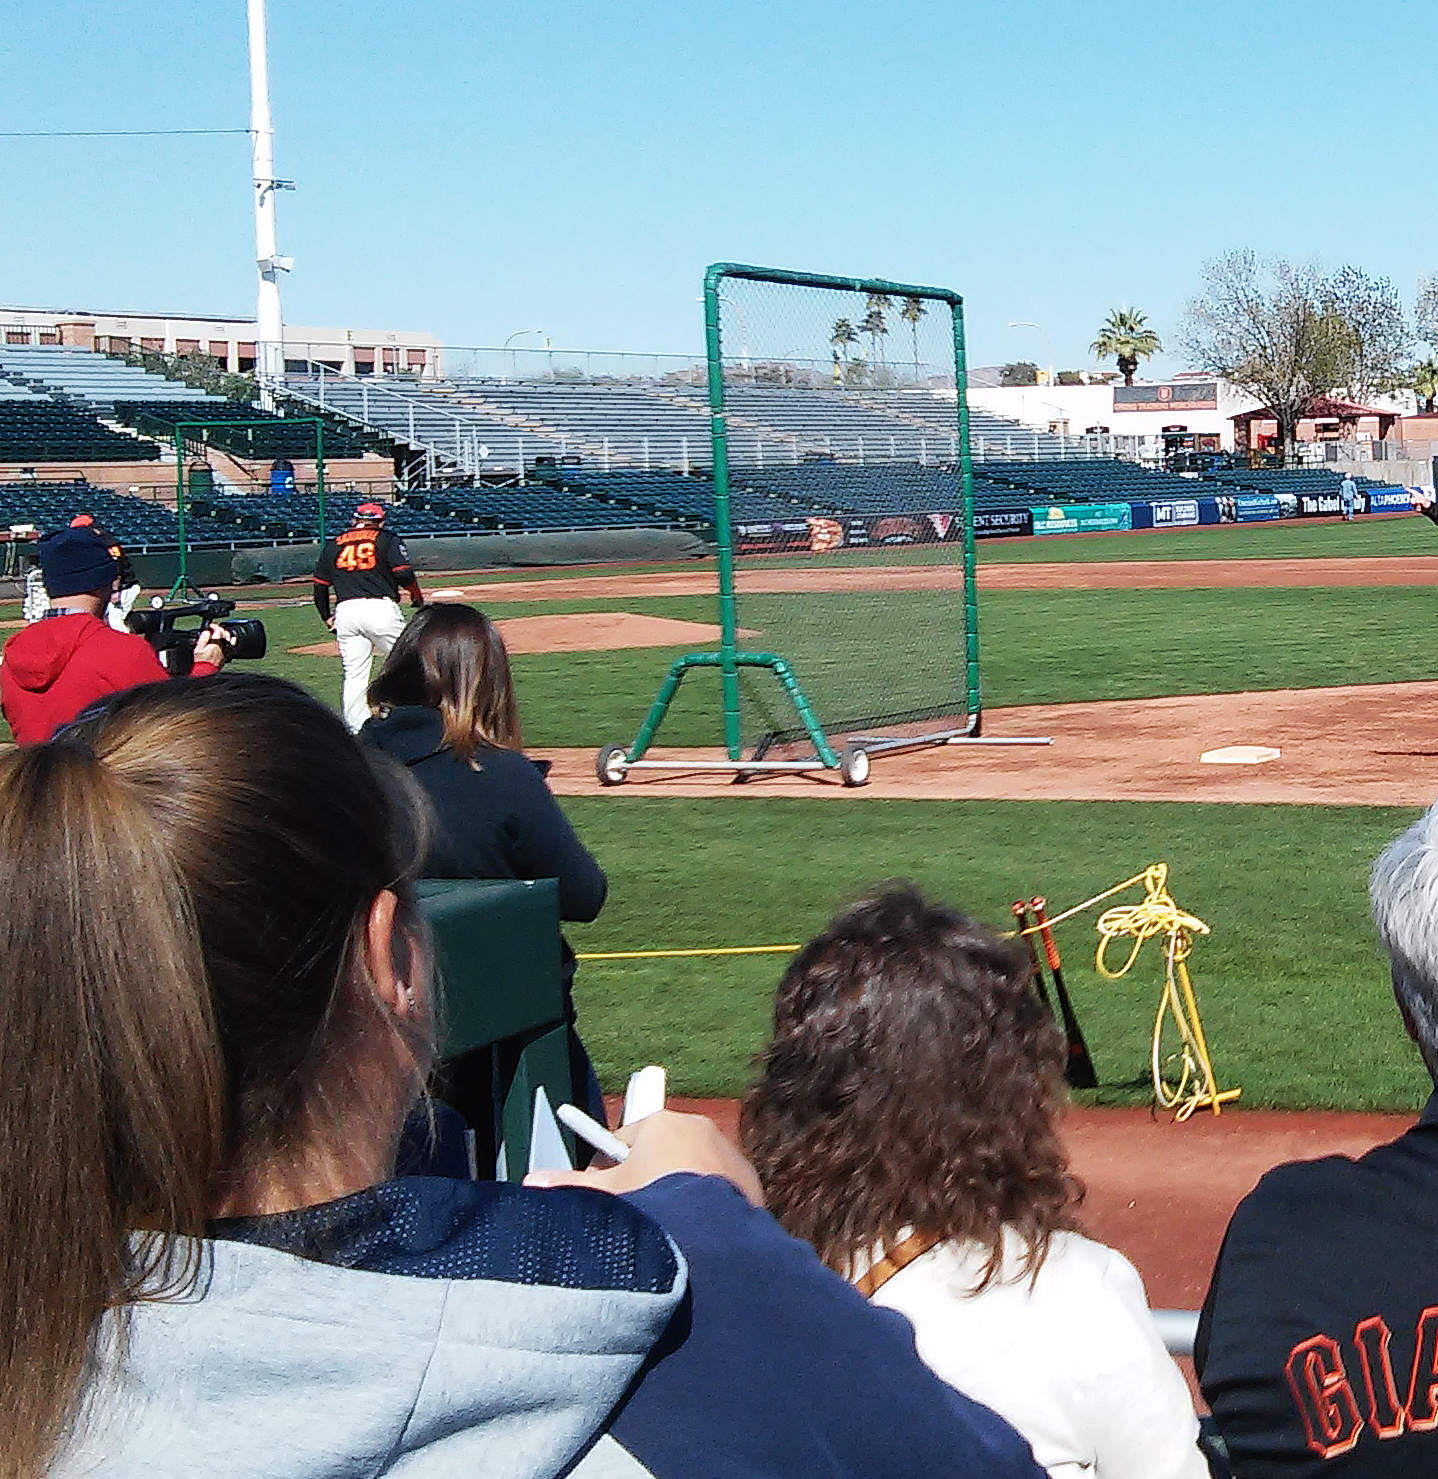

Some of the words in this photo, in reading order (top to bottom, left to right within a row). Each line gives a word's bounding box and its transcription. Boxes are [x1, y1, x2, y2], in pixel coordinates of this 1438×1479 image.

[1302, 497, 1318, 513] The
[991, 513, 1029, 526] SECURITY
[1156, 506, 1172, 520] MT
